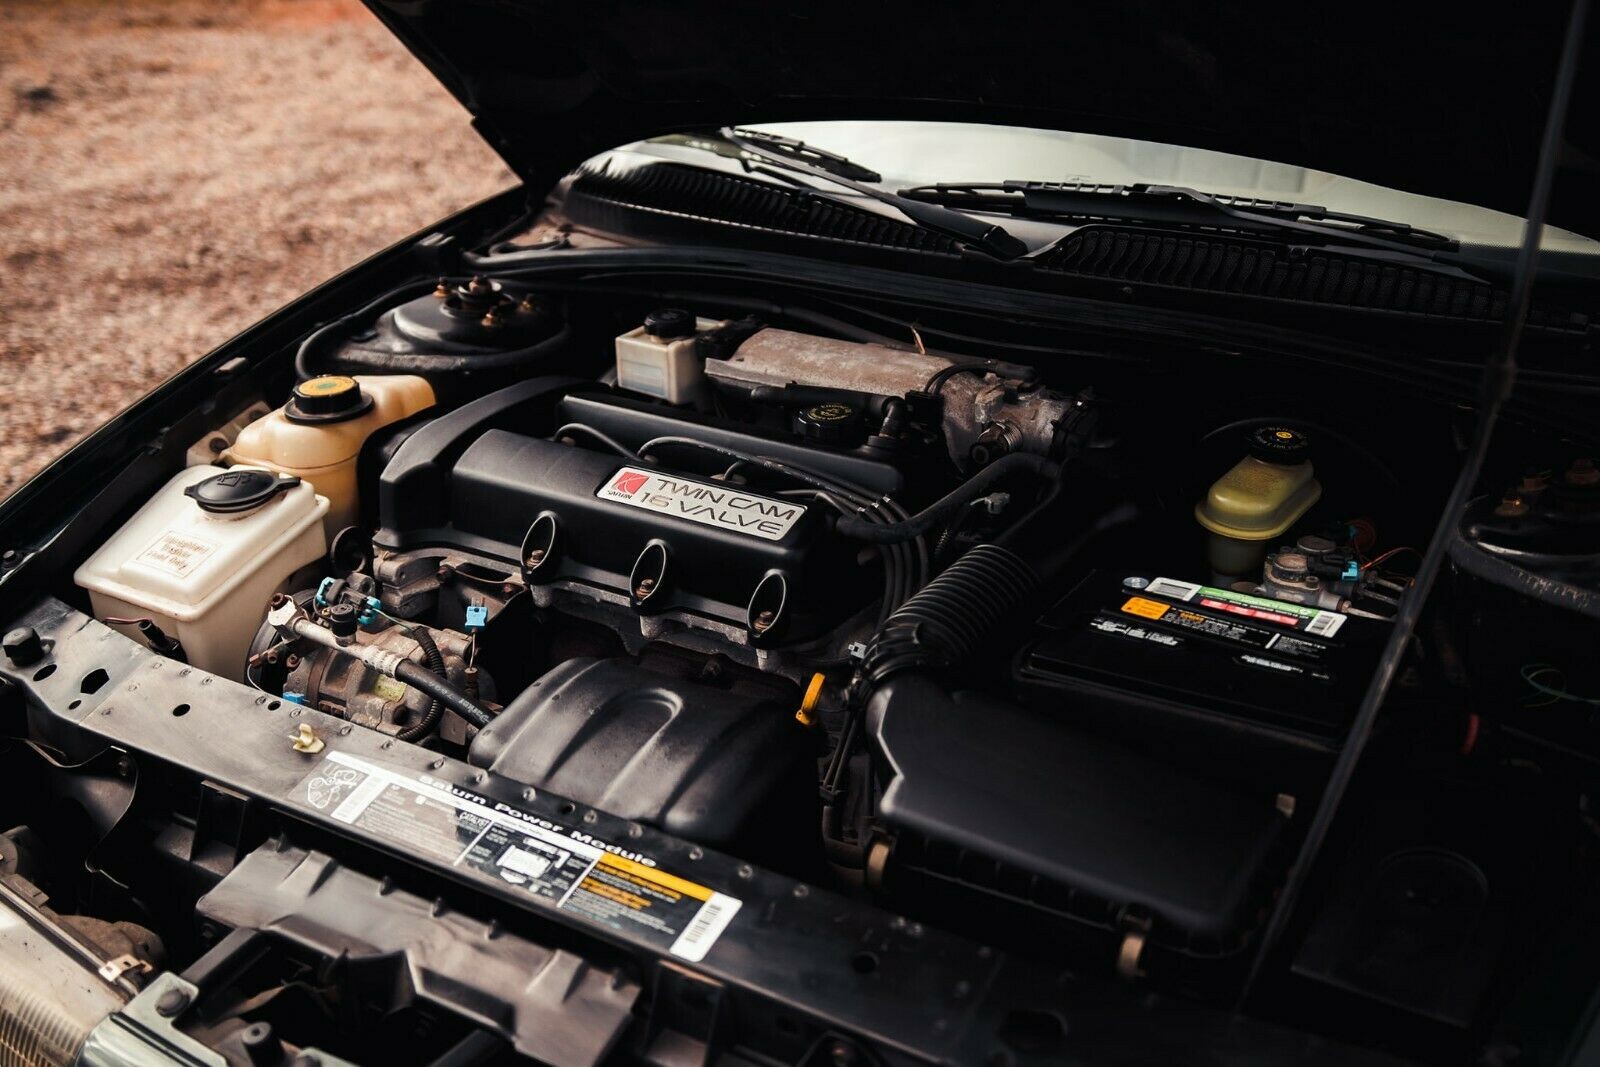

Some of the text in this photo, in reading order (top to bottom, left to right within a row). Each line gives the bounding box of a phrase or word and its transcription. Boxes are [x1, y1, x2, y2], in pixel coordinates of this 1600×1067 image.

[639, 492, 784, 535] 16 VALVE
[656, 479, 796, 520] TWIN CAM
[418, 775, 486, 805] Saturn
[495, 802, 564, 833] Power
[571, 830, 657, 868] Module
